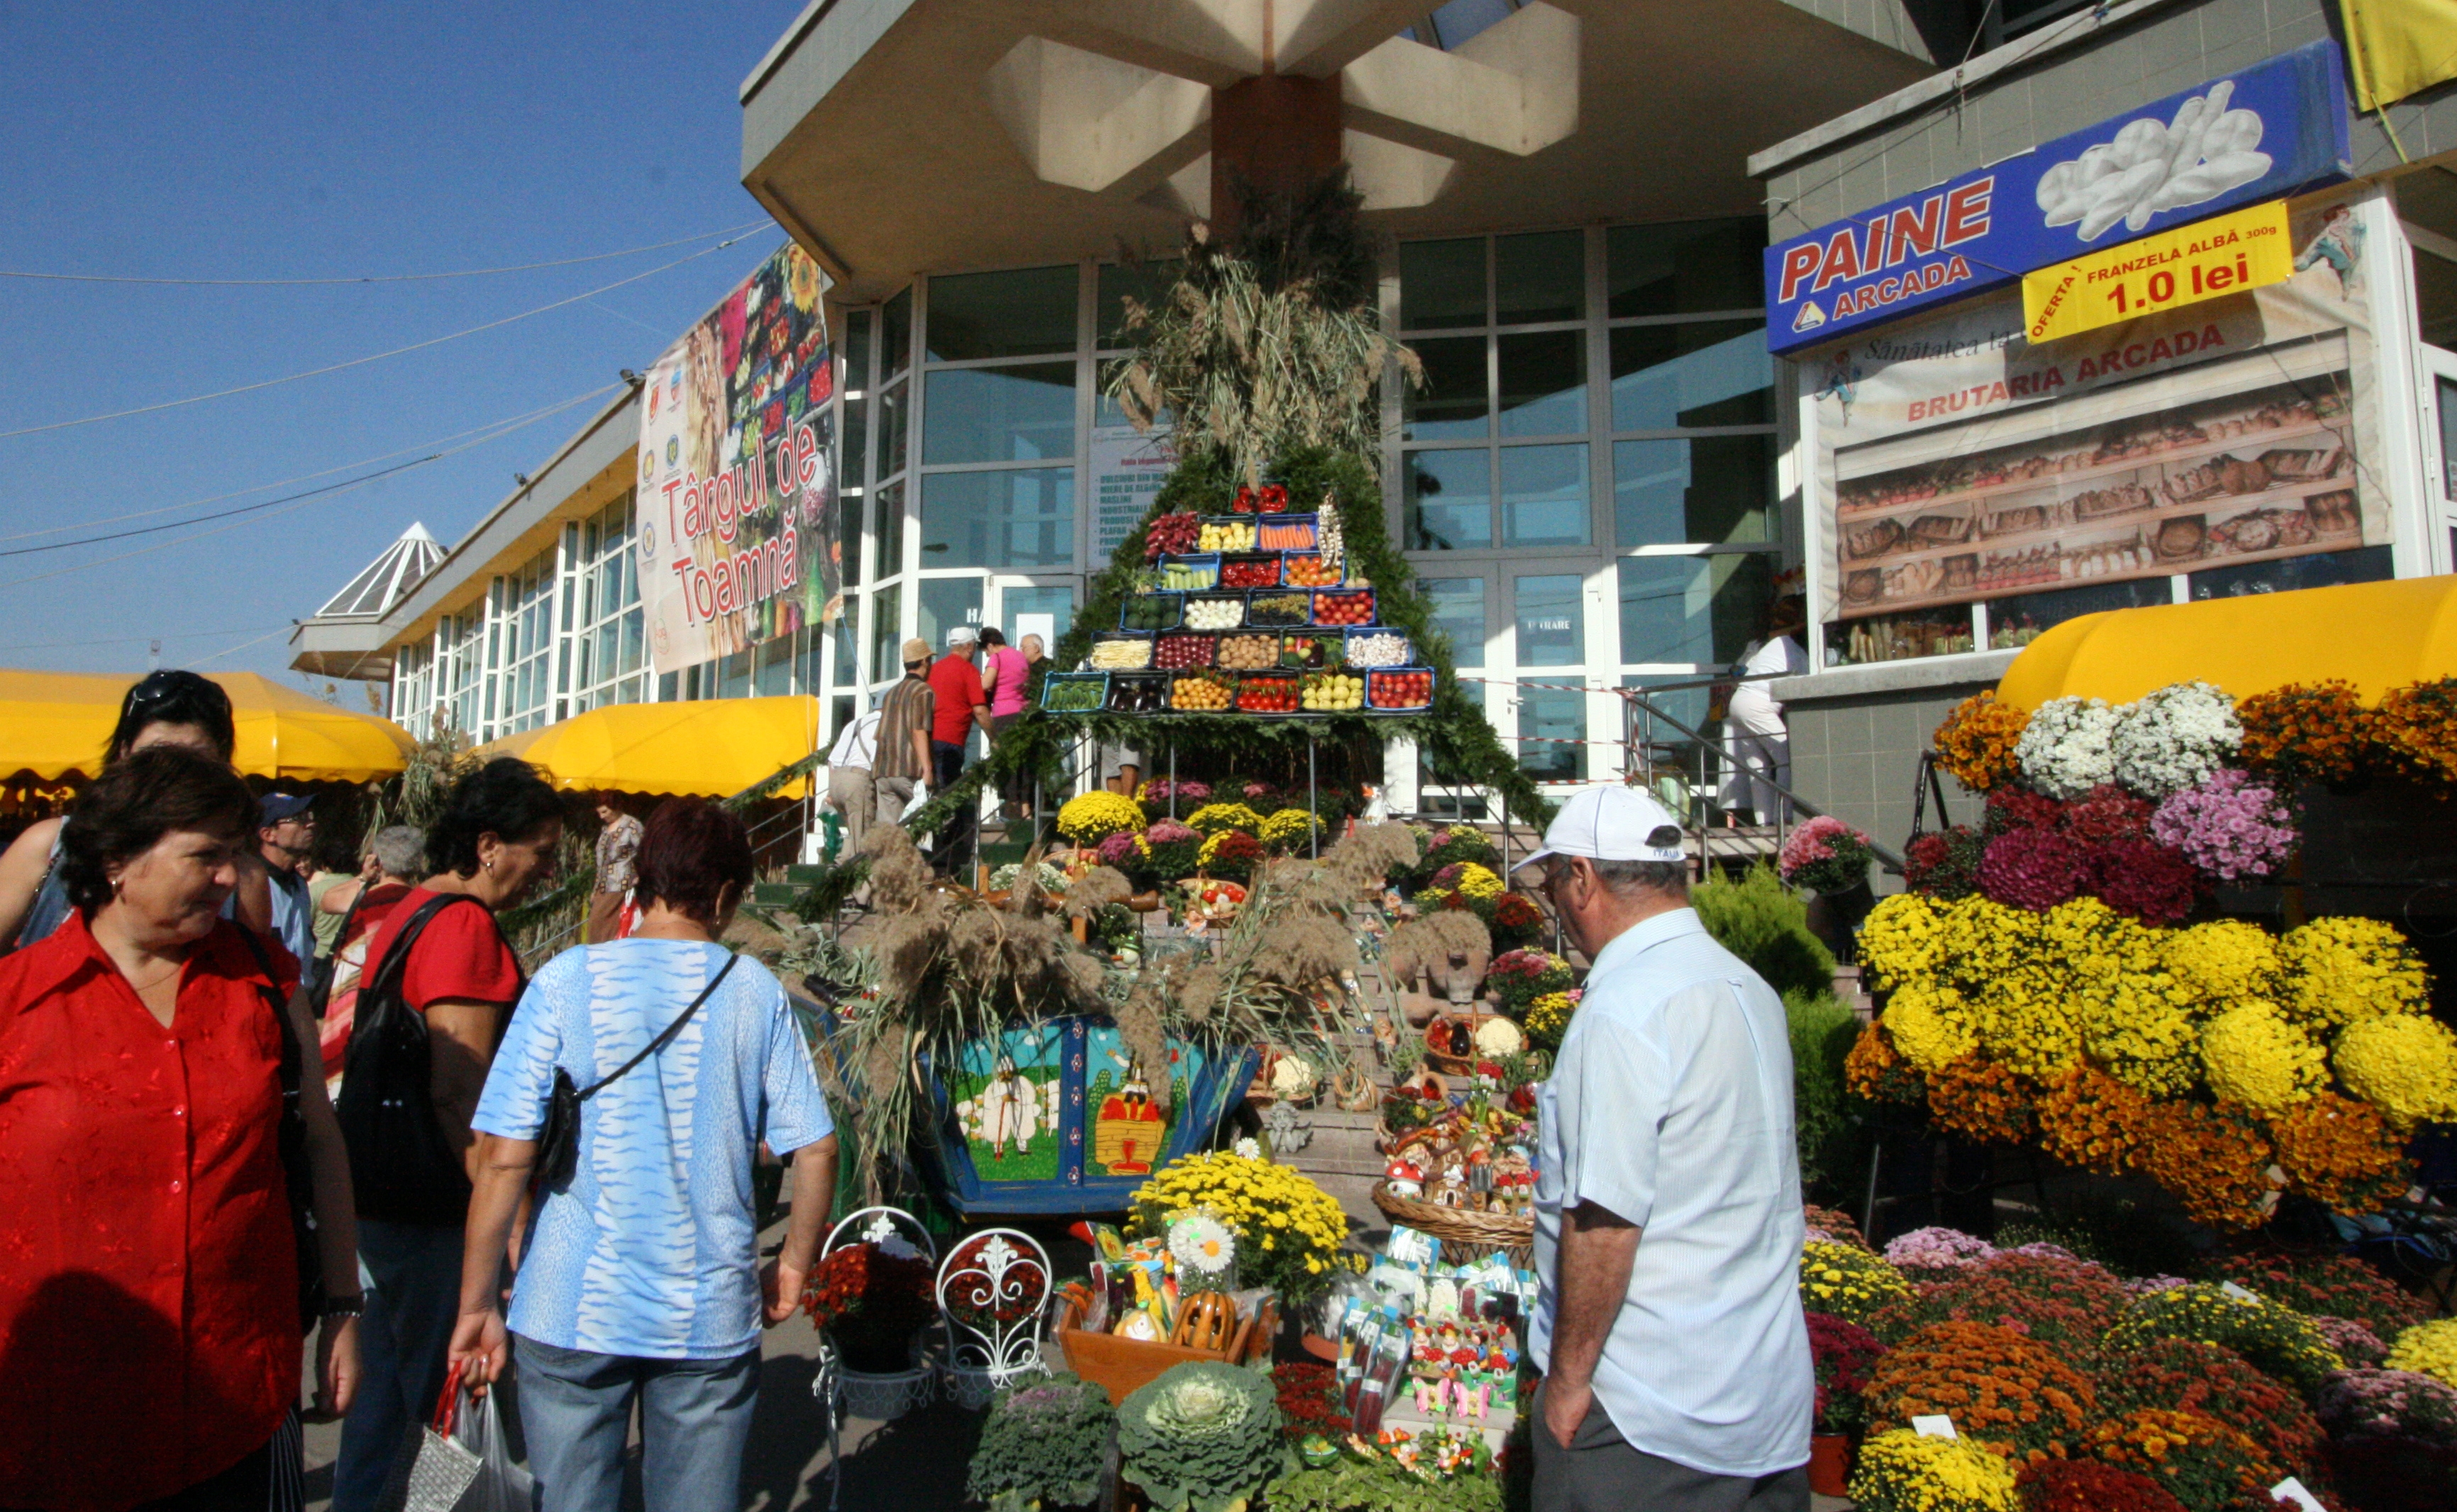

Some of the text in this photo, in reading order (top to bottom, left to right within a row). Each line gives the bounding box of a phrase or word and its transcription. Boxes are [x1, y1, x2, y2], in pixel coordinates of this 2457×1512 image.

[1778, 176, 1995, 304] PAINE
[2087, 226, 2277, 284] FRANZELA ALBĂ 300g
[1832, 255, 1972, 321] ARCADA
[2031, 277, 2075, 338] OFERTA
[2107, 252, 2248, 313] 1.0 lei
[1907, 324, 2224, 423] BRUTARIA ARCADA
[661, 415, 817, 545] Târgul de
[672, 507, 797, 627] Toamnă
